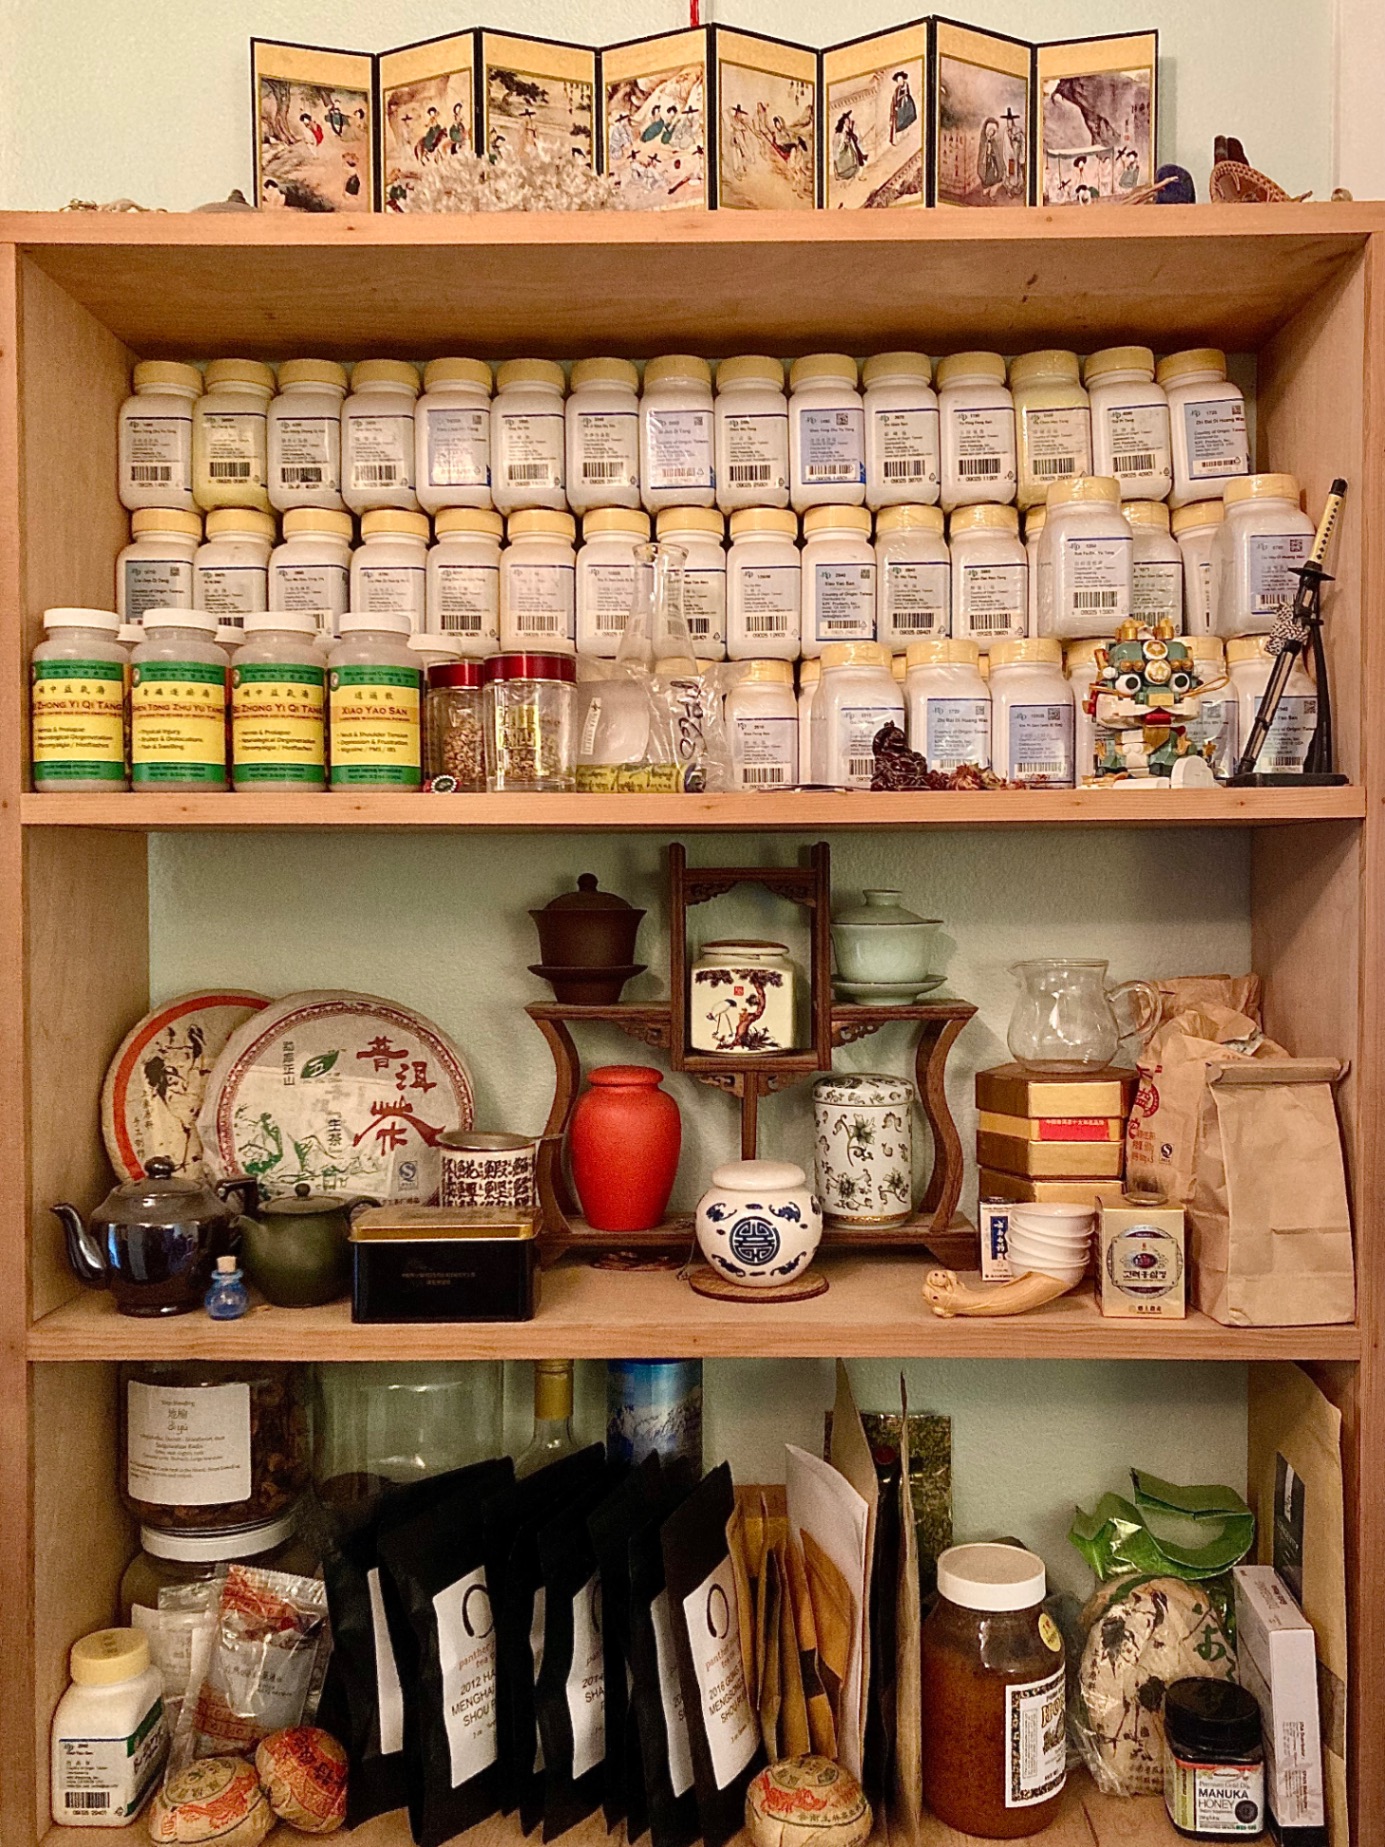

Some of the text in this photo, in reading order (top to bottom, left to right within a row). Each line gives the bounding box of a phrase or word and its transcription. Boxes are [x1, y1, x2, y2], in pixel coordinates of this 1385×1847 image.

[342, 706, 408, 715] XIAO YAO SAN
[460, 1676, 481, 1696] 2012
[708, 1681, 725, 1701] 2016
[463, 1704, 490, 1728] SHOU
[1198, 1788, 1249, 1800] MANUKA
[1198, 1799, 1235, 1809] HONEY
